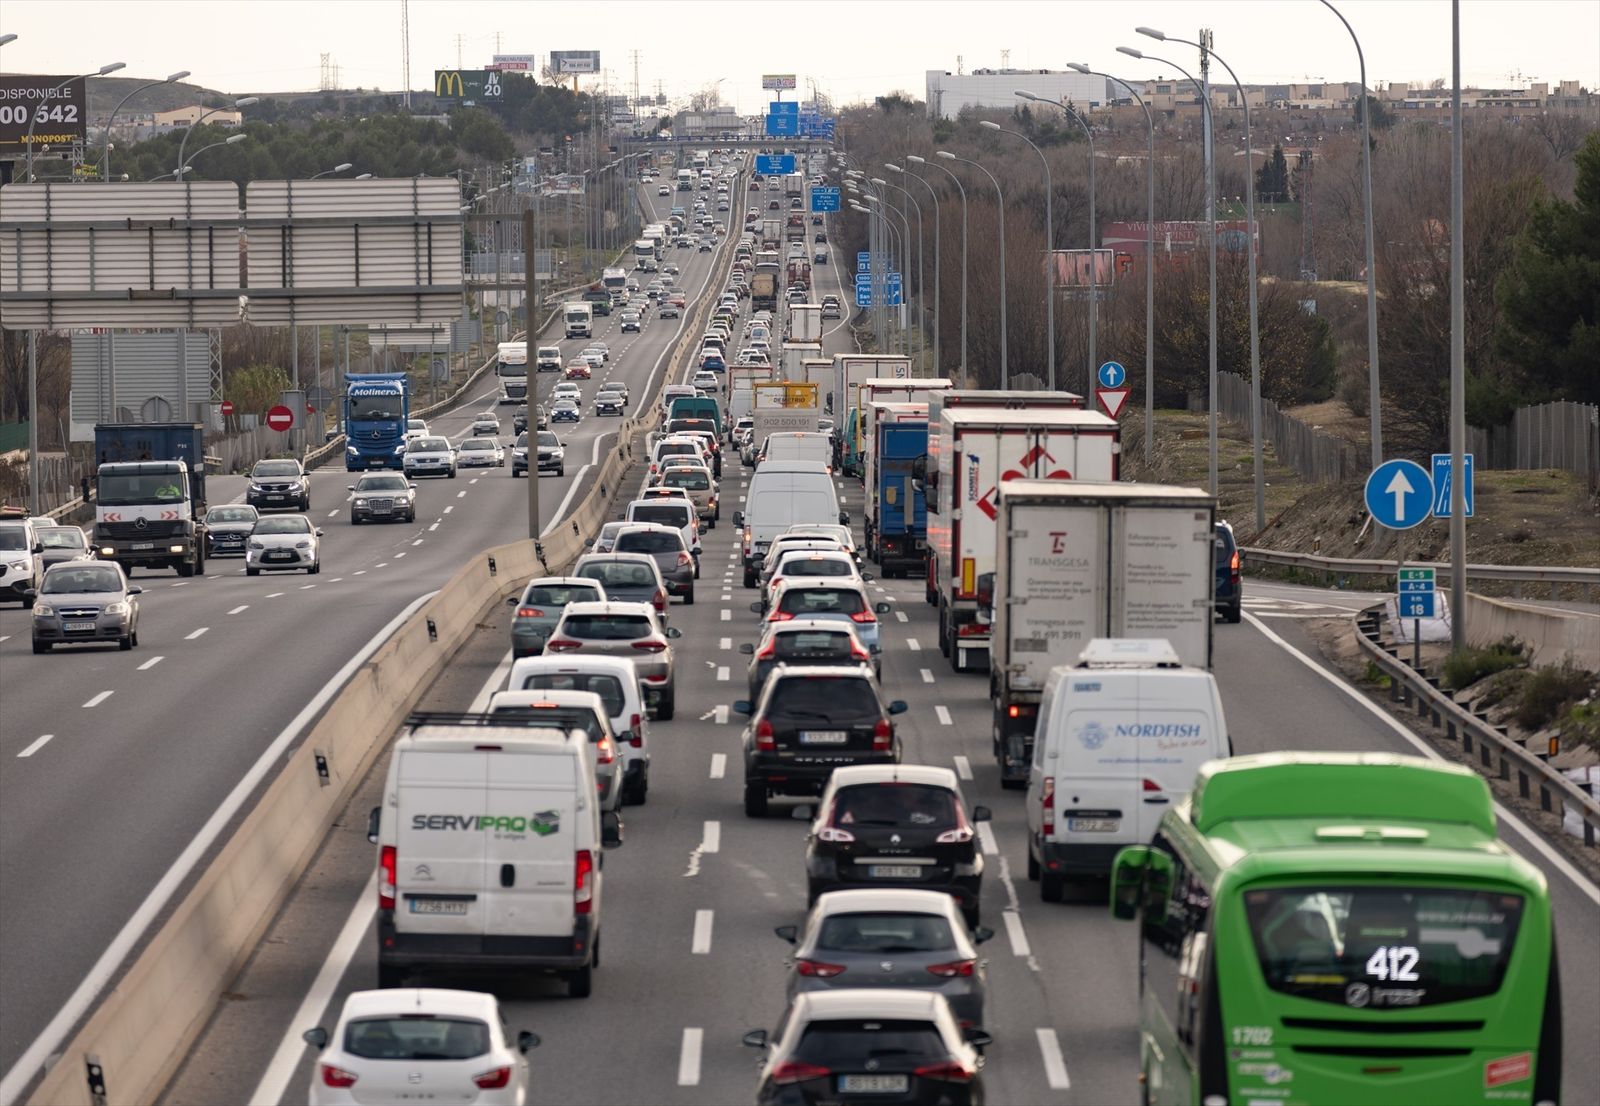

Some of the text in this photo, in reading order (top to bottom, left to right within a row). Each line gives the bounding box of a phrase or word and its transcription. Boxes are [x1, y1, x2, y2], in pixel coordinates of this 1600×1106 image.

[0, 87, 72, 99] DISPONIBLE
[484, 84, 501, 96] 20
[35, 104, 78, 124] 542
[354, 388, 396, 396] Molinero
[763, 418, 810, 426] 902 500 191
[1028, 558, 1090, 568] TRANSGESA
[1408, 571, 1425, 580] E-5
[1408, 582, 1426, 590] A-4
[1409, 604, 1425, 616] 18
[1027, 619, 1085, 628] transgesa.com
[1031, 630, 1081, 639] 91 691 3911
[1115, 724, 1200, 737] NORDFISH
[412, 814, 527, 832] SERVIPAQ
[1366, 945, 1420, 981] 412
[1232, 1026, 1273, 1046] 1702
